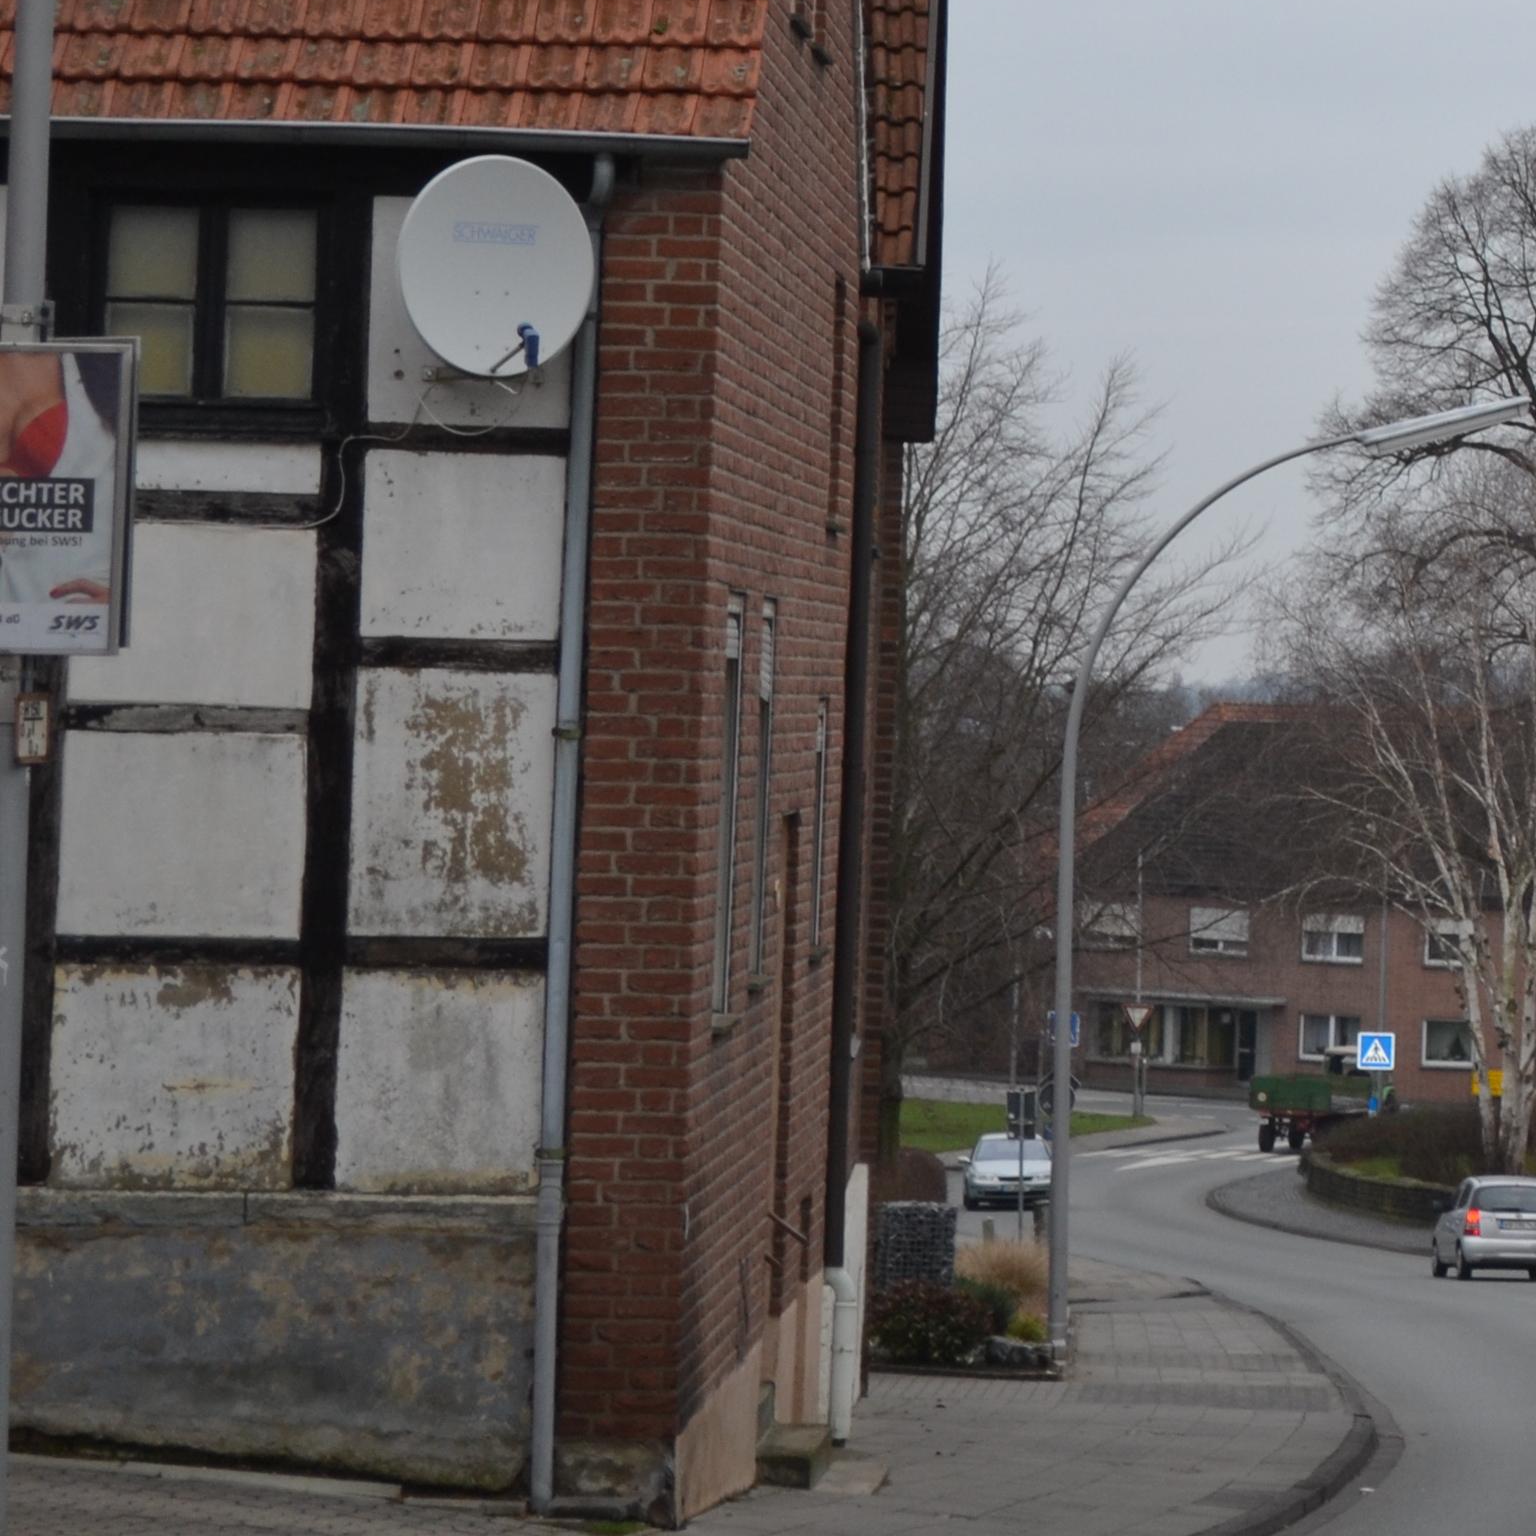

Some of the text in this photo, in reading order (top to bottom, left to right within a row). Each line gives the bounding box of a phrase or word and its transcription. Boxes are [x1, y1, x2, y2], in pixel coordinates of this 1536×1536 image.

[0, 482, 85, 504] CHTER
[0, 507, 83, 529] UCKER
[49, 615, 100, 630] SWS
